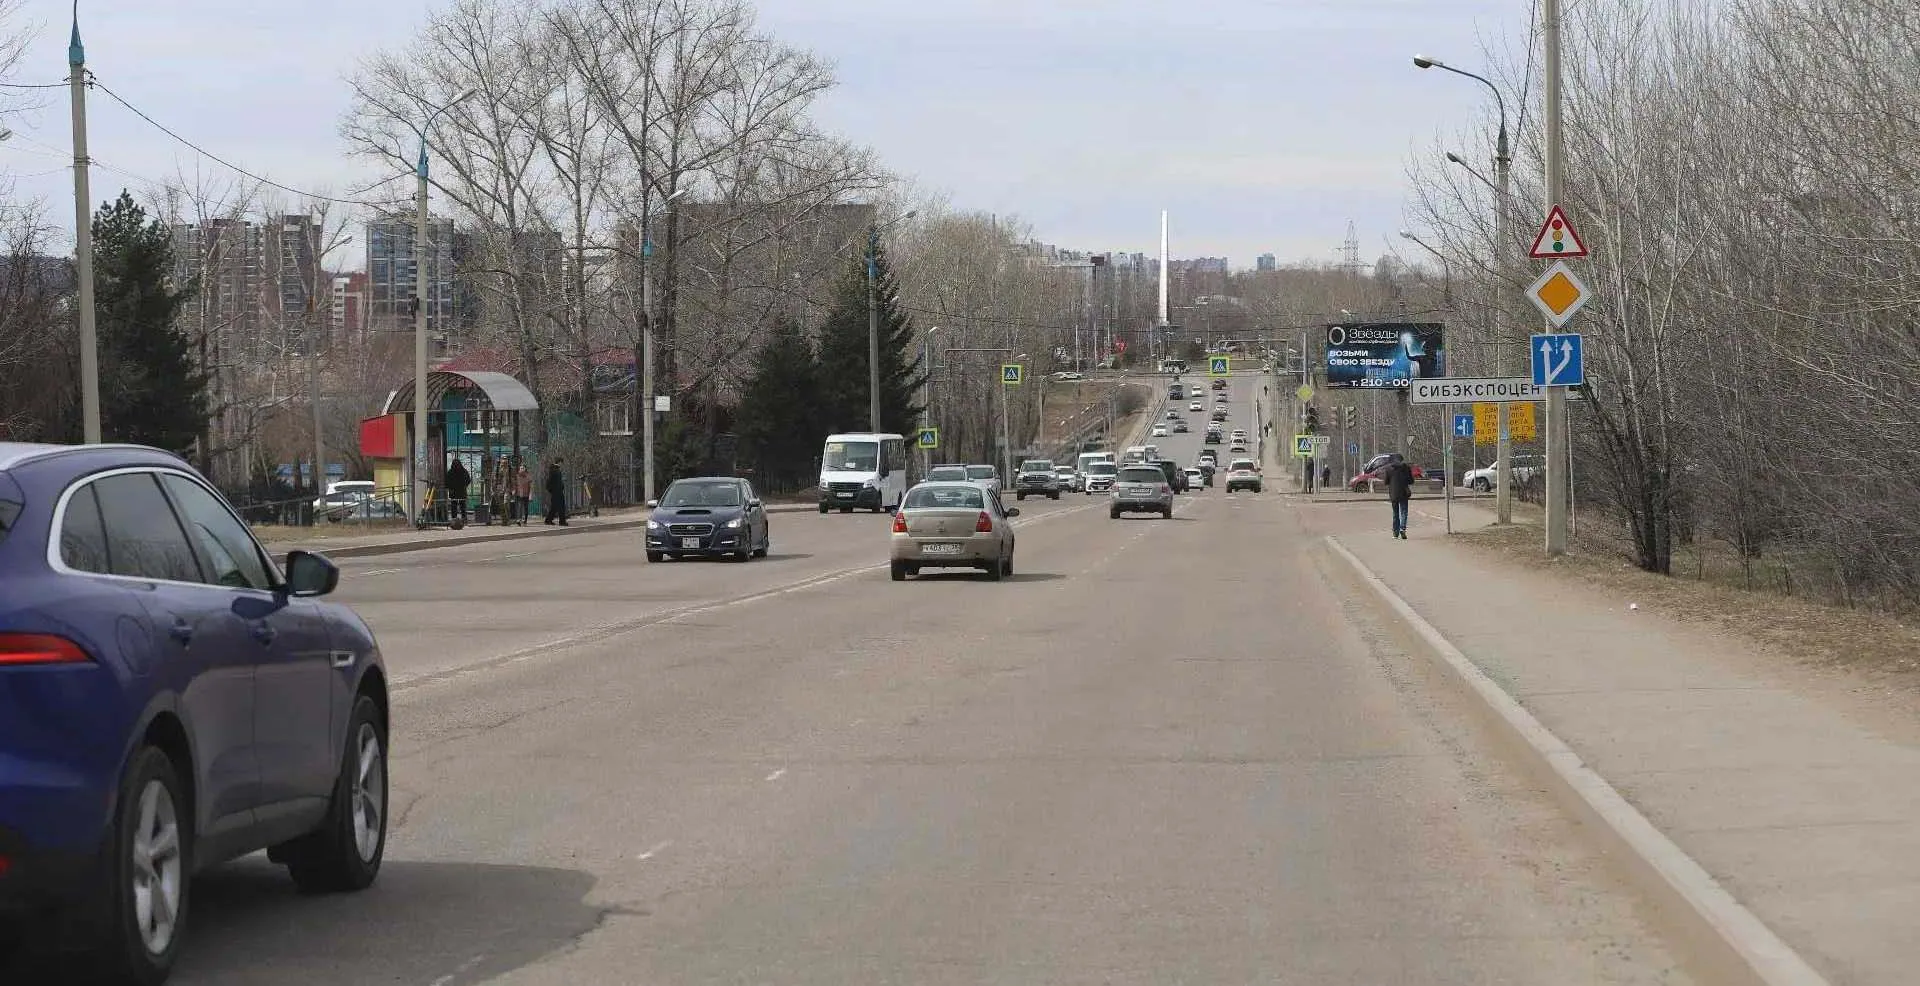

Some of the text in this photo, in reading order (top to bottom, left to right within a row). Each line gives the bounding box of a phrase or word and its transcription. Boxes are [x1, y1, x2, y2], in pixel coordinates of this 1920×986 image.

[1329, 358, 1396, 367] СВОЮ ЗВЕЗДУ
[1419, 384, 1541, 397] СИБЭКСПОЦЕН
